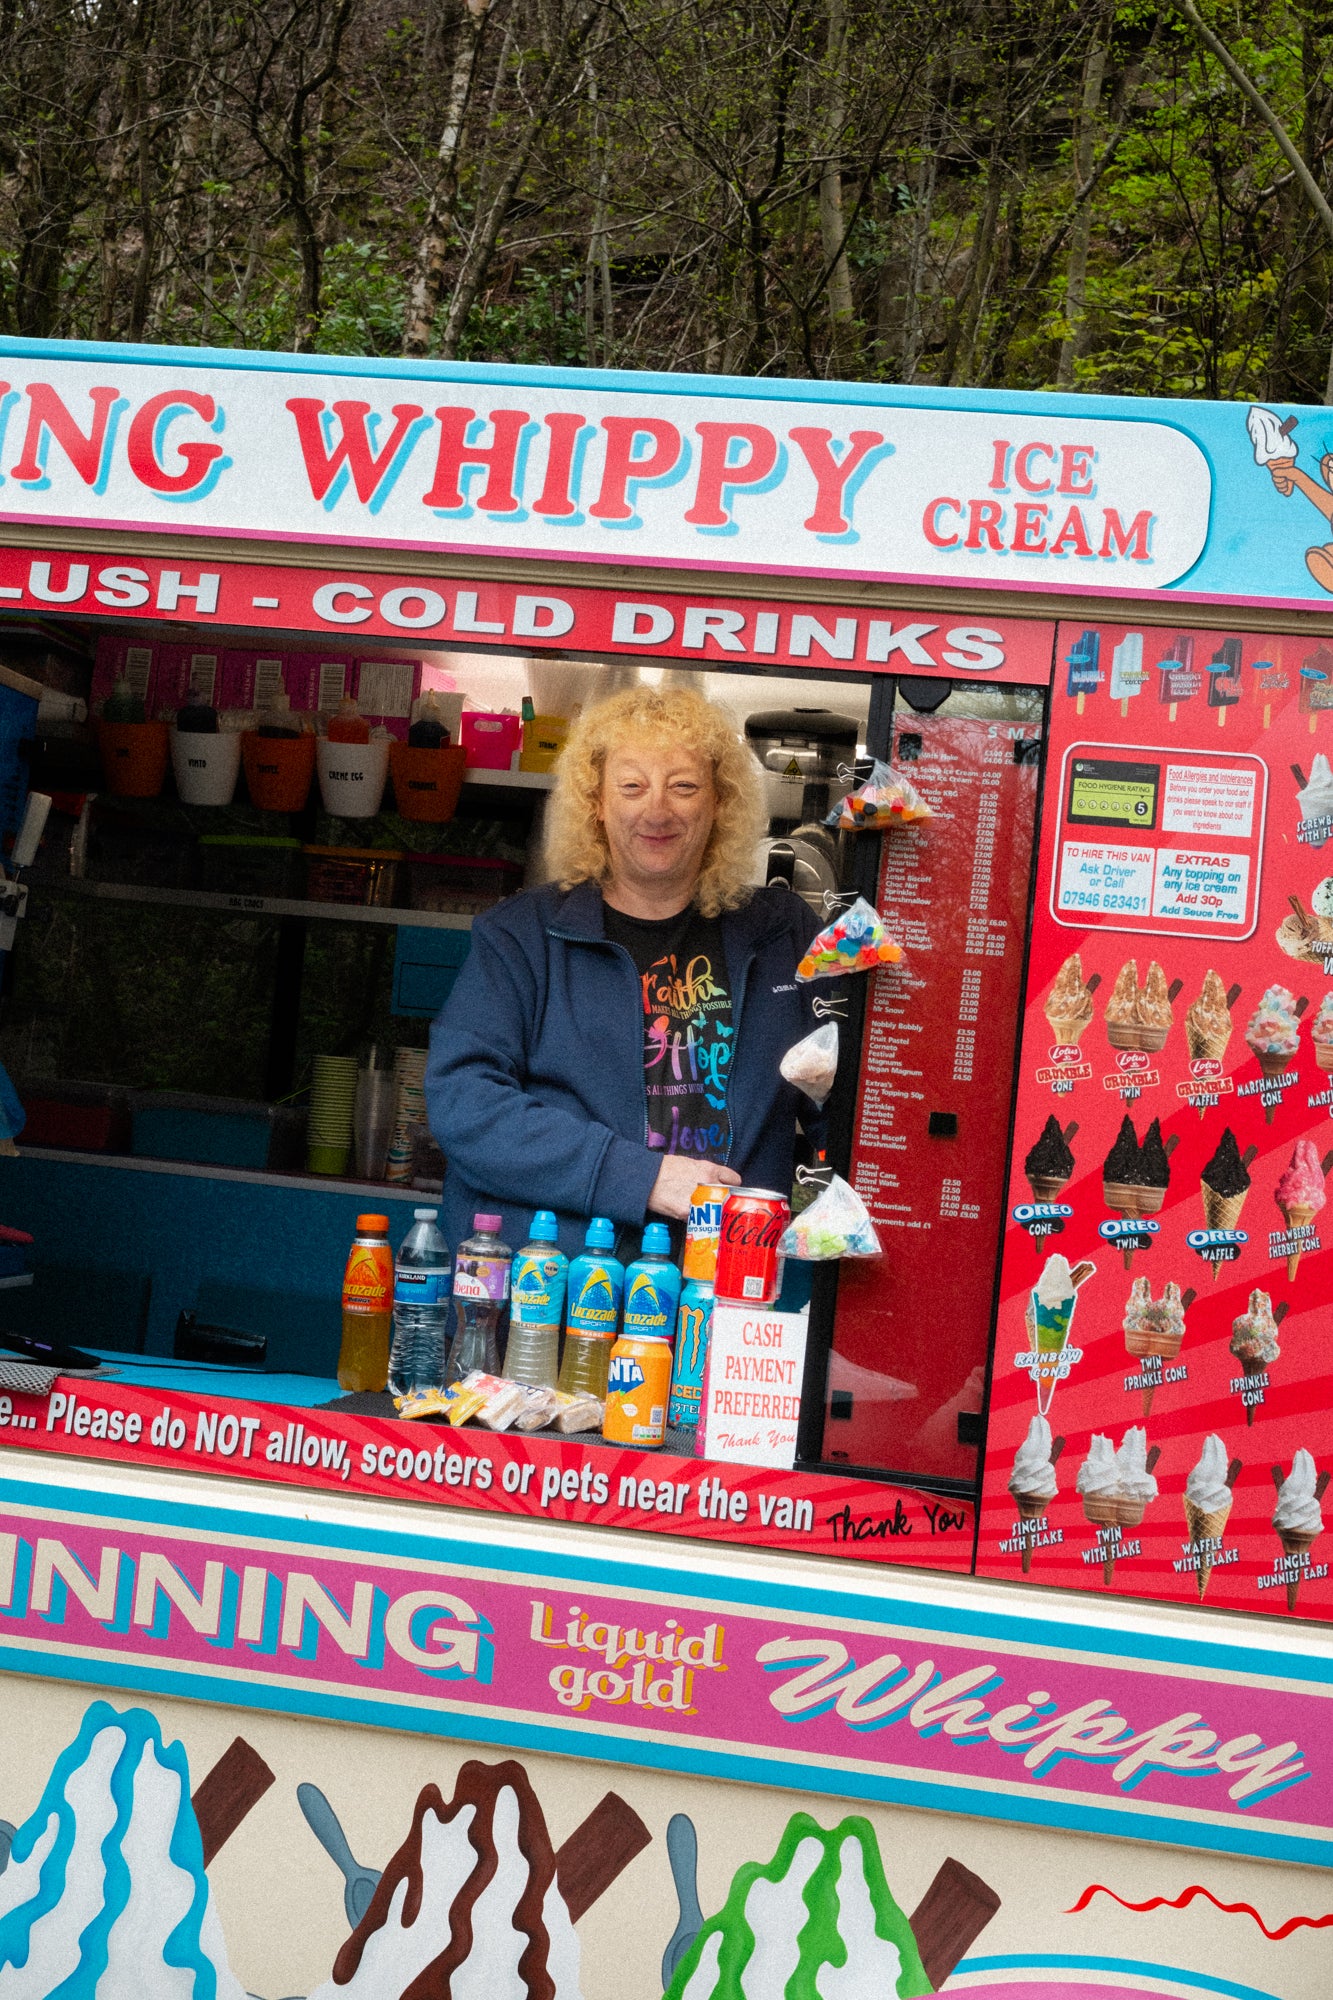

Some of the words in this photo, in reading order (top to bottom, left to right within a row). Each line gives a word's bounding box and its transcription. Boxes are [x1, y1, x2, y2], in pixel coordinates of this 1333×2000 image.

[0, 382, 226, 498] NG
[286, 398, 890, 540] WHIPPY
[988, 440, 1096, 496] ICE
[923, 497, 1154, 561] CREAM
[312, 582, 575, 637] COLD
[611, 602, 1005, 670] DRINKS
[987, 726, 998, 738] S
[1007, 727, 1024, 740] M
[1169, 769, 1182, 779] Food
[1184, 770, 1207, 783] Allergies
[1209, 773, 1218, 781] and
[1220, 773, 1253, 784] Intolerances
[1170, 783, 1186, 791] Before
[1188, 786, 1197, 794] you
[1213, 788, 1224, 796] your
[1137, 803, 1145, 814] 5
[1067, 847, 1080, 856] TO
[1081, 849, 1103, 859] HIRE
[1107, 851, 1128, 861] THIS
[1131, 852, 1150, 863] VAN
[1175, 854, 1230, 867] EXTRAS
[1080, 863, 1099, 875] Ask
[1103, 865, 1136, 877] Driver
[1162, 866, 1182, 880] Any
[1186, 868, 1224, 883] topping
[1228, 872, 1241, 882] on
[1089, 878, 1101, 887] or
[1104, 877, 1124, 889] Call
[1164, 881, 1182, 892] any
[1186, 880, 1200, 891] ice
[1204, 885, 1238, 894] cream
[1063, 891, 1099, 907] 07946
[1103, 894, 1147, 910] 623431
[1176, 893, 1196, 904] Add
[1201, 895, 1223, 908] 30p
[1160, 905, 1179, 915] Add
[1216, 910, 1239, 920] Free
[876, 976, 900, 985] Cherry
[902, 979, 927, 988] Brandy
[874, 991, 911, 1000] Lemonade
[702, 1000, 733, 1011] POSSIBLE
[870, 1035, 886, 1043] Fruit
[868, 1050, 895, 1058] Festival
[1052, 1047, 1079, 1057] Lotus
[1119, 1053, 1146, 1065] Lotus
[868, 1058, 902, 1067] Magnums
[1192, 1061, 1220, 1072] Lotus
[867, 1065, 889, 1073] Vegan
[891, 1068, 923, 1076] Magnum
[1037, 1065, 1091, 1082] CRUMBLE
[1052, 1081, 1073, 1093] CONE
[1104, 1072, 1158, 1088] CRUMBLE
[1178, 1079, 1232, 1096] CRUMBLE
[1237, 1072, 1299, 1096] MARSHMALLOW
[663, 1084, 687, 1096] THINGS
[881, 1089, 908, 1098] Topping
[911, 1092, 924, 1100] 50p
[1120, 1087, 1141, 1099] TWIN
[863, 1102, 895, 1111] Sprinkles
[1188, 1095, 1219, 1106] WAFFLE
[1261, 1092, 1282, 1107] CONE
[862, 1117, 893, 1126] Smarties
[856, 1169, 878, 1177] 330ml
[857, 1162, 879, 1170] Drinks
[855, 1177, 877, 1185] 500ml
[879, 1179, 900, 1187] Water
[855, 1185, 880, 1193] Bottles
[1013, 1204, 1072, 1219] OREO
[726, 1209, 780, 1248] Cola
[870, 1216, 905, 1227] Payments
[907, 1220, 921, 1228] add
[1029, 1223, 1052, 1236] CONE
[1100, 1220, 1158, 1235] OREO
[1189, 1230, 1247, 1244] OREO
[1269, 1225, 1316, 1244] STRAWBERRY
[1116, 1237, 1138, 1250] TWIN
[1269, 1241, 1299, 1259] SHERBET
[1300, 1237, 1320, 1252] CONE
[1202, 1247, 1234, 1261] WAFFLE
[398, 1273, 426, 1282] KIRKLAND
[571, 1301, 617, 1322] Lucozade
[580, 1319, 608, 1328] SPORT
[742, 1321, 783, 1348] CASH
[1016, 1349, 1081, 1365] RAINBOW
[1141, 1356, 1162, 1371] TWIN
[725, 1355, 796, 1385] PAYMENT
[1032, 1366, 1070, 1379] CONE
[1124, 1370, 1162, 1391] SPRINKLE
[1165, 1365, 1188, 1381] CONE
[1230, 1373, 1269, 1394] SPRINKLE
[714, 1390, 801, 1421] PREFERRED
[1241, 1390, 1264, 1407] CONE
[717, 1431, 760, 1449] Thank
[767, 1429, 798, 1449] You
[45, 1392, 143, 1444] Please
[150, 1406, 186, 1451] do
[194, 1411, 261, 1458] NOT
[265, 1423, 351, 1481] allow,
[360, 1441, 493, 1490] scooters
[501, 1460, 533, 1495] or
[540, 1461, 609, 1508] pets
[618, 1474, 691, 1515] near
[698, 1477, 748, 1523] the
[758, 1493, 815, 1532] van
[827, 1500, 913, 1543] Thank
[923, 1503, 966, 1536] You
[1012, 1518, 1048, 1537] SINGLE
[999, 1535, 1028, 1553] WITH
[1031, 1529, 1063, 1548] FLAKE
[1096, 1527, 1122, 1545] TWIN
[1081, 1547, 1107, 1565] WITH
[1111, 1540, 1141, 1559] FLAKE
[1182, 1537, 1223, 1555] WAFFLE
[1173, 1555, 1203, 1573] WITH
[1206, 1548, 1239, 1567] FLAKE
[1273, 1553, 1311, 1572] SINGLE
[1257, 1569, 1300, 1589] BUNNIES
[1303, 1564, 1328, 1581] EARS
[529, 1600, 727, 1672] Liquid
[548, 1659, 698, 1714] gold
[756, 1637, 1310, 1805] Whippy
